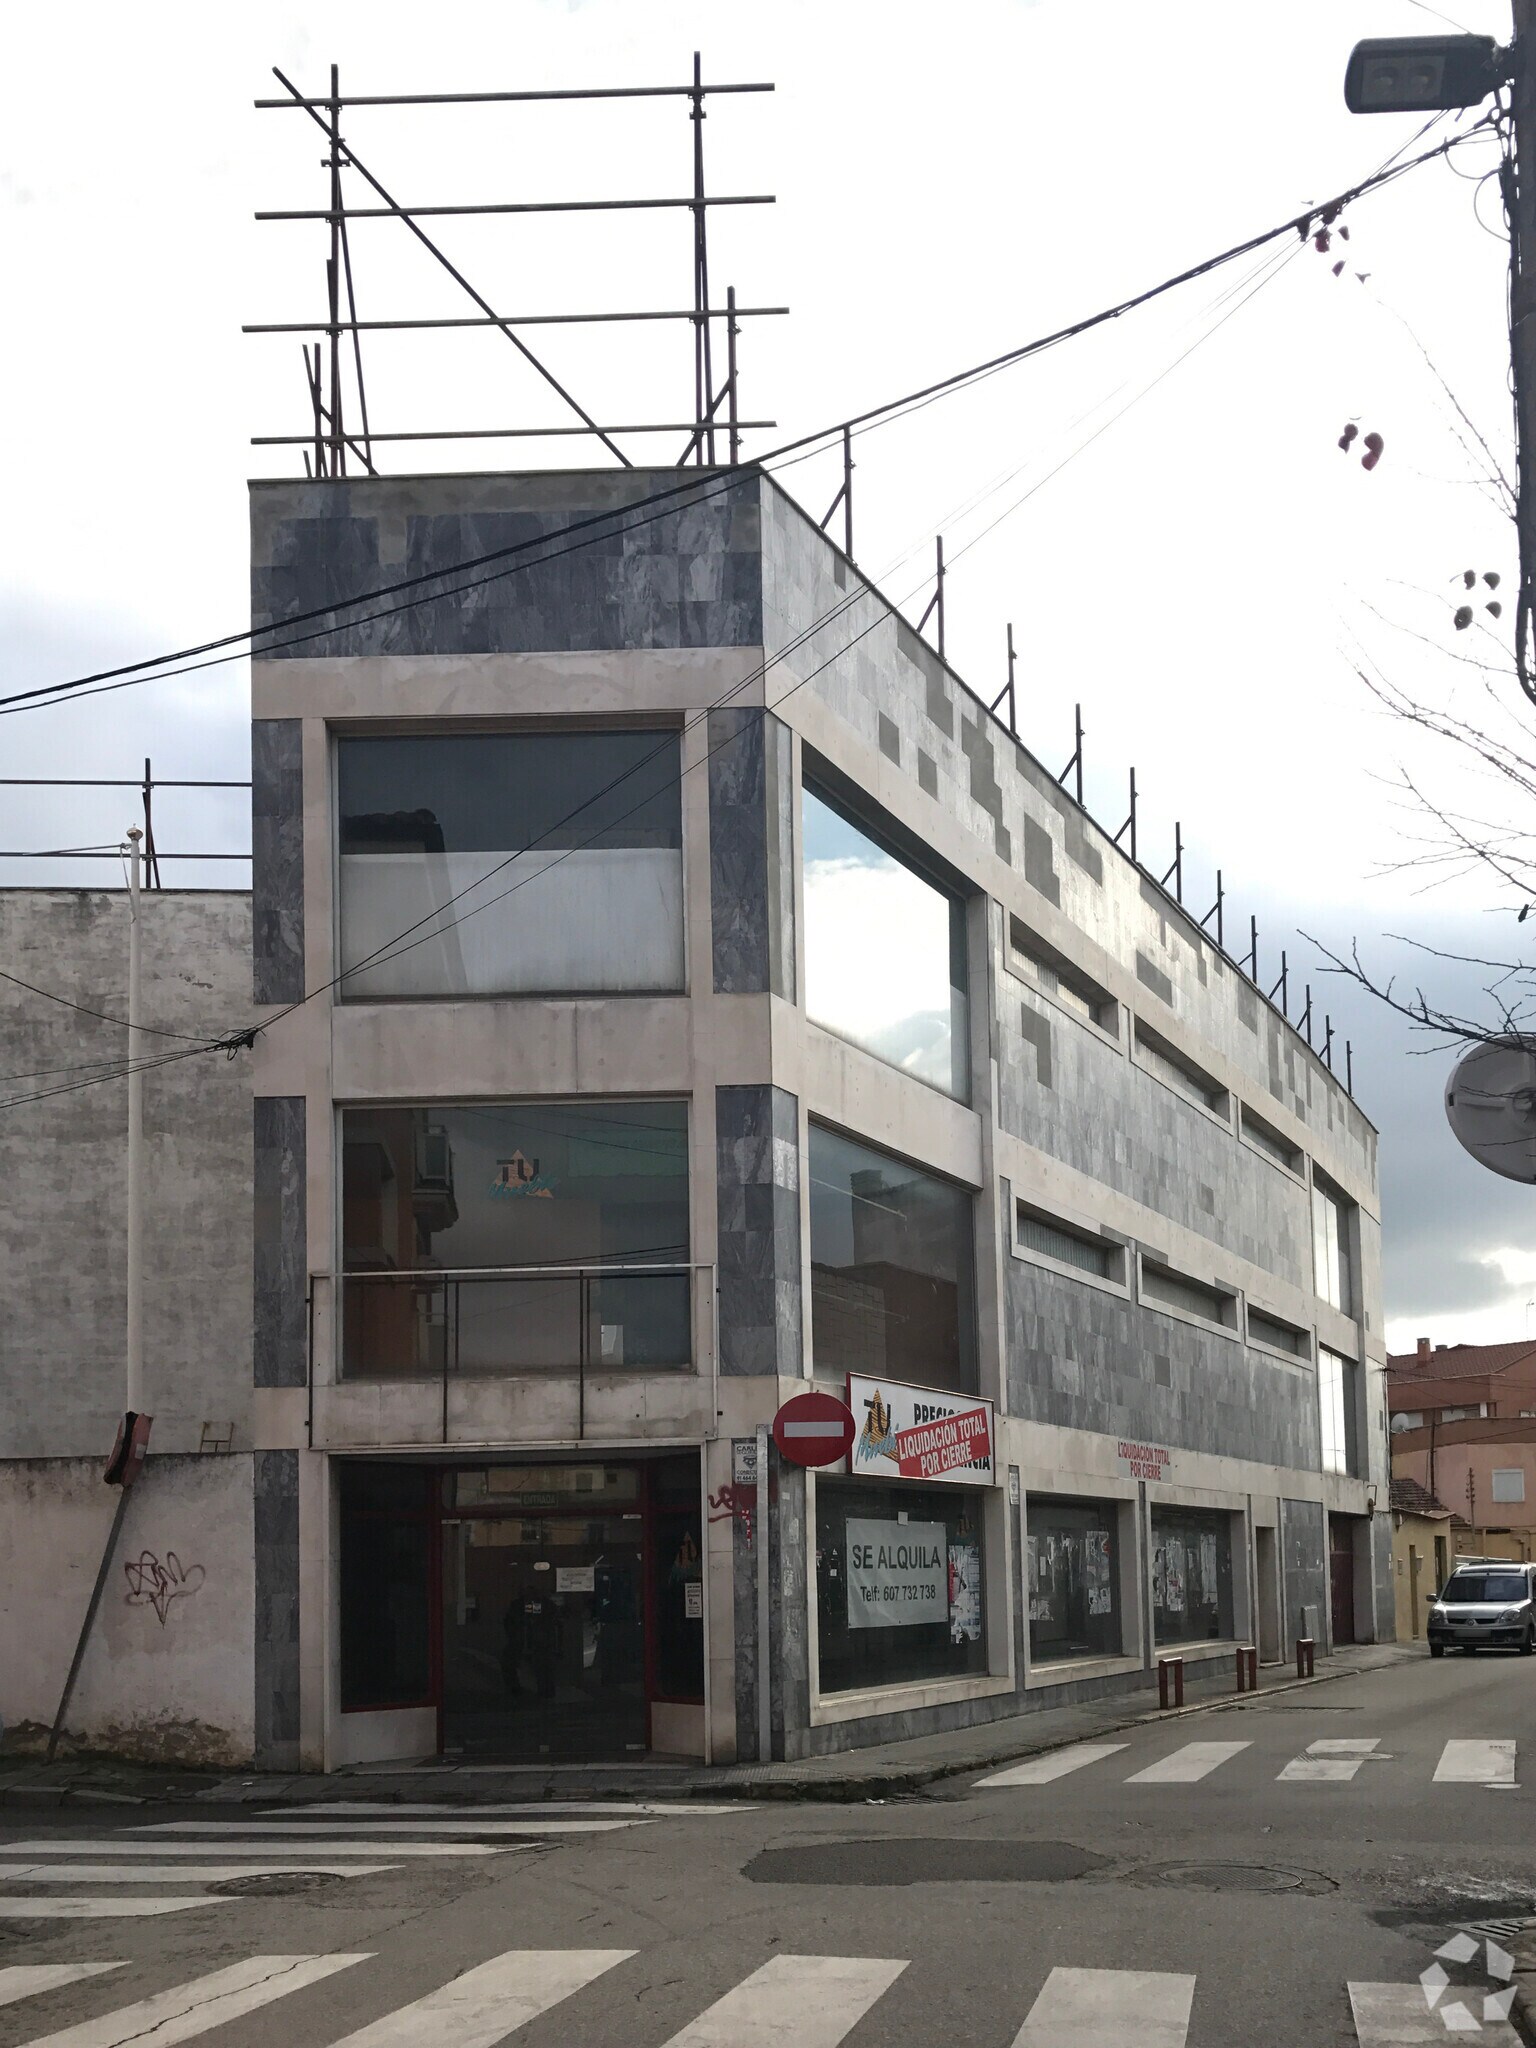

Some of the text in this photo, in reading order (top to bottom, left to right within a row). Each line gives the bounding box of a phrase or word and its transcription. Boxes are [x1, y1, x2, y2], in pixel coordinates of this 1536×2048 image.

[496, 1158, 539, 1183] TU
[864, 1398, 891, 1436] TU
[898, 1413, 986, 1461] LIQUIDACIÓN TOTAL
[920, 1452, 940, 1477] POR
[941, 1440, 973, 1470] CIERRE
[1154, 1447, 1170, 1466] TOTAL
[1130, 1460, 1162, 1481] POR CIERRE
[852, 1544, 942, 1571] SE ALQUILA
[860, 1584, 936, 1602] Telf: 607 732 738
